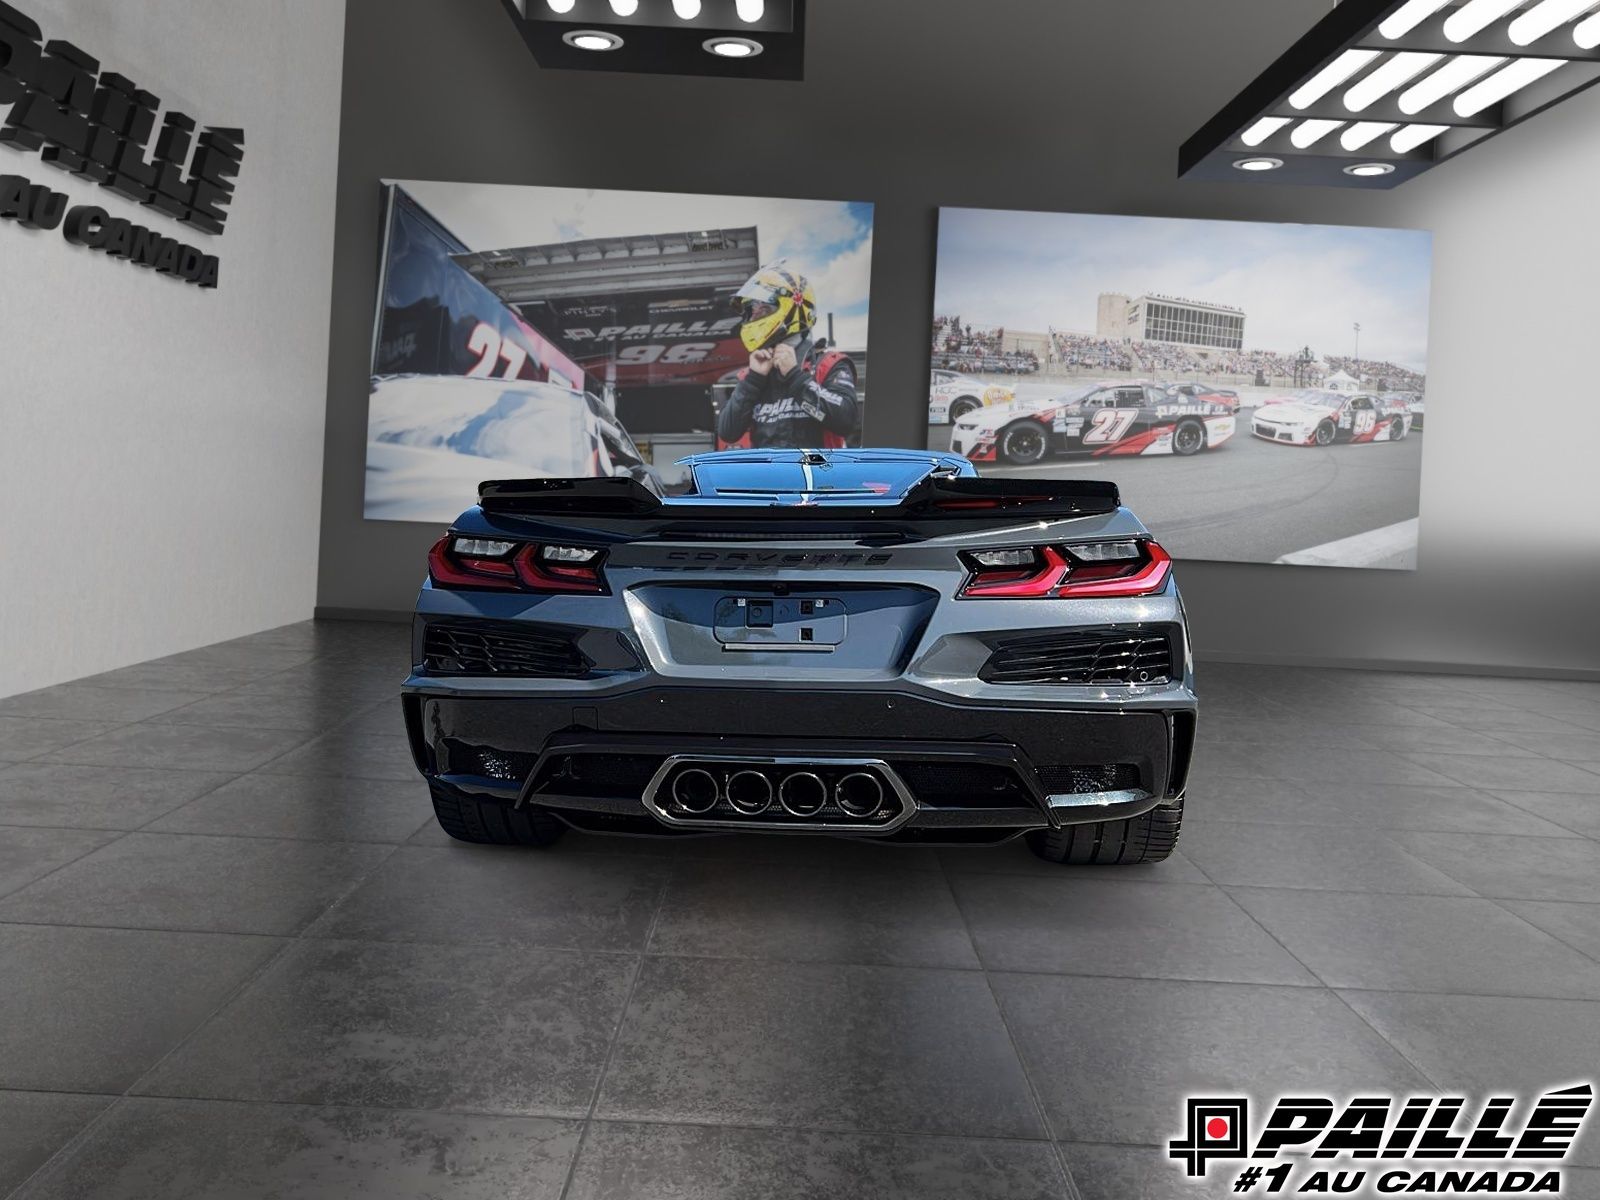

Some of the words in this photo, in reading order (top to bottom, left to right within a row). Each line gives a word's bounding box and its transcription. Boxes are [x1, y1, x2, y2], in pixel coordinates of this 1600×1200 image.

[63, 205, 219, 288] CANADA
[464, 322, 527, 380] 27
[615, 342, 716, 365] 96
[1083, 408, 1140, 445] 27
